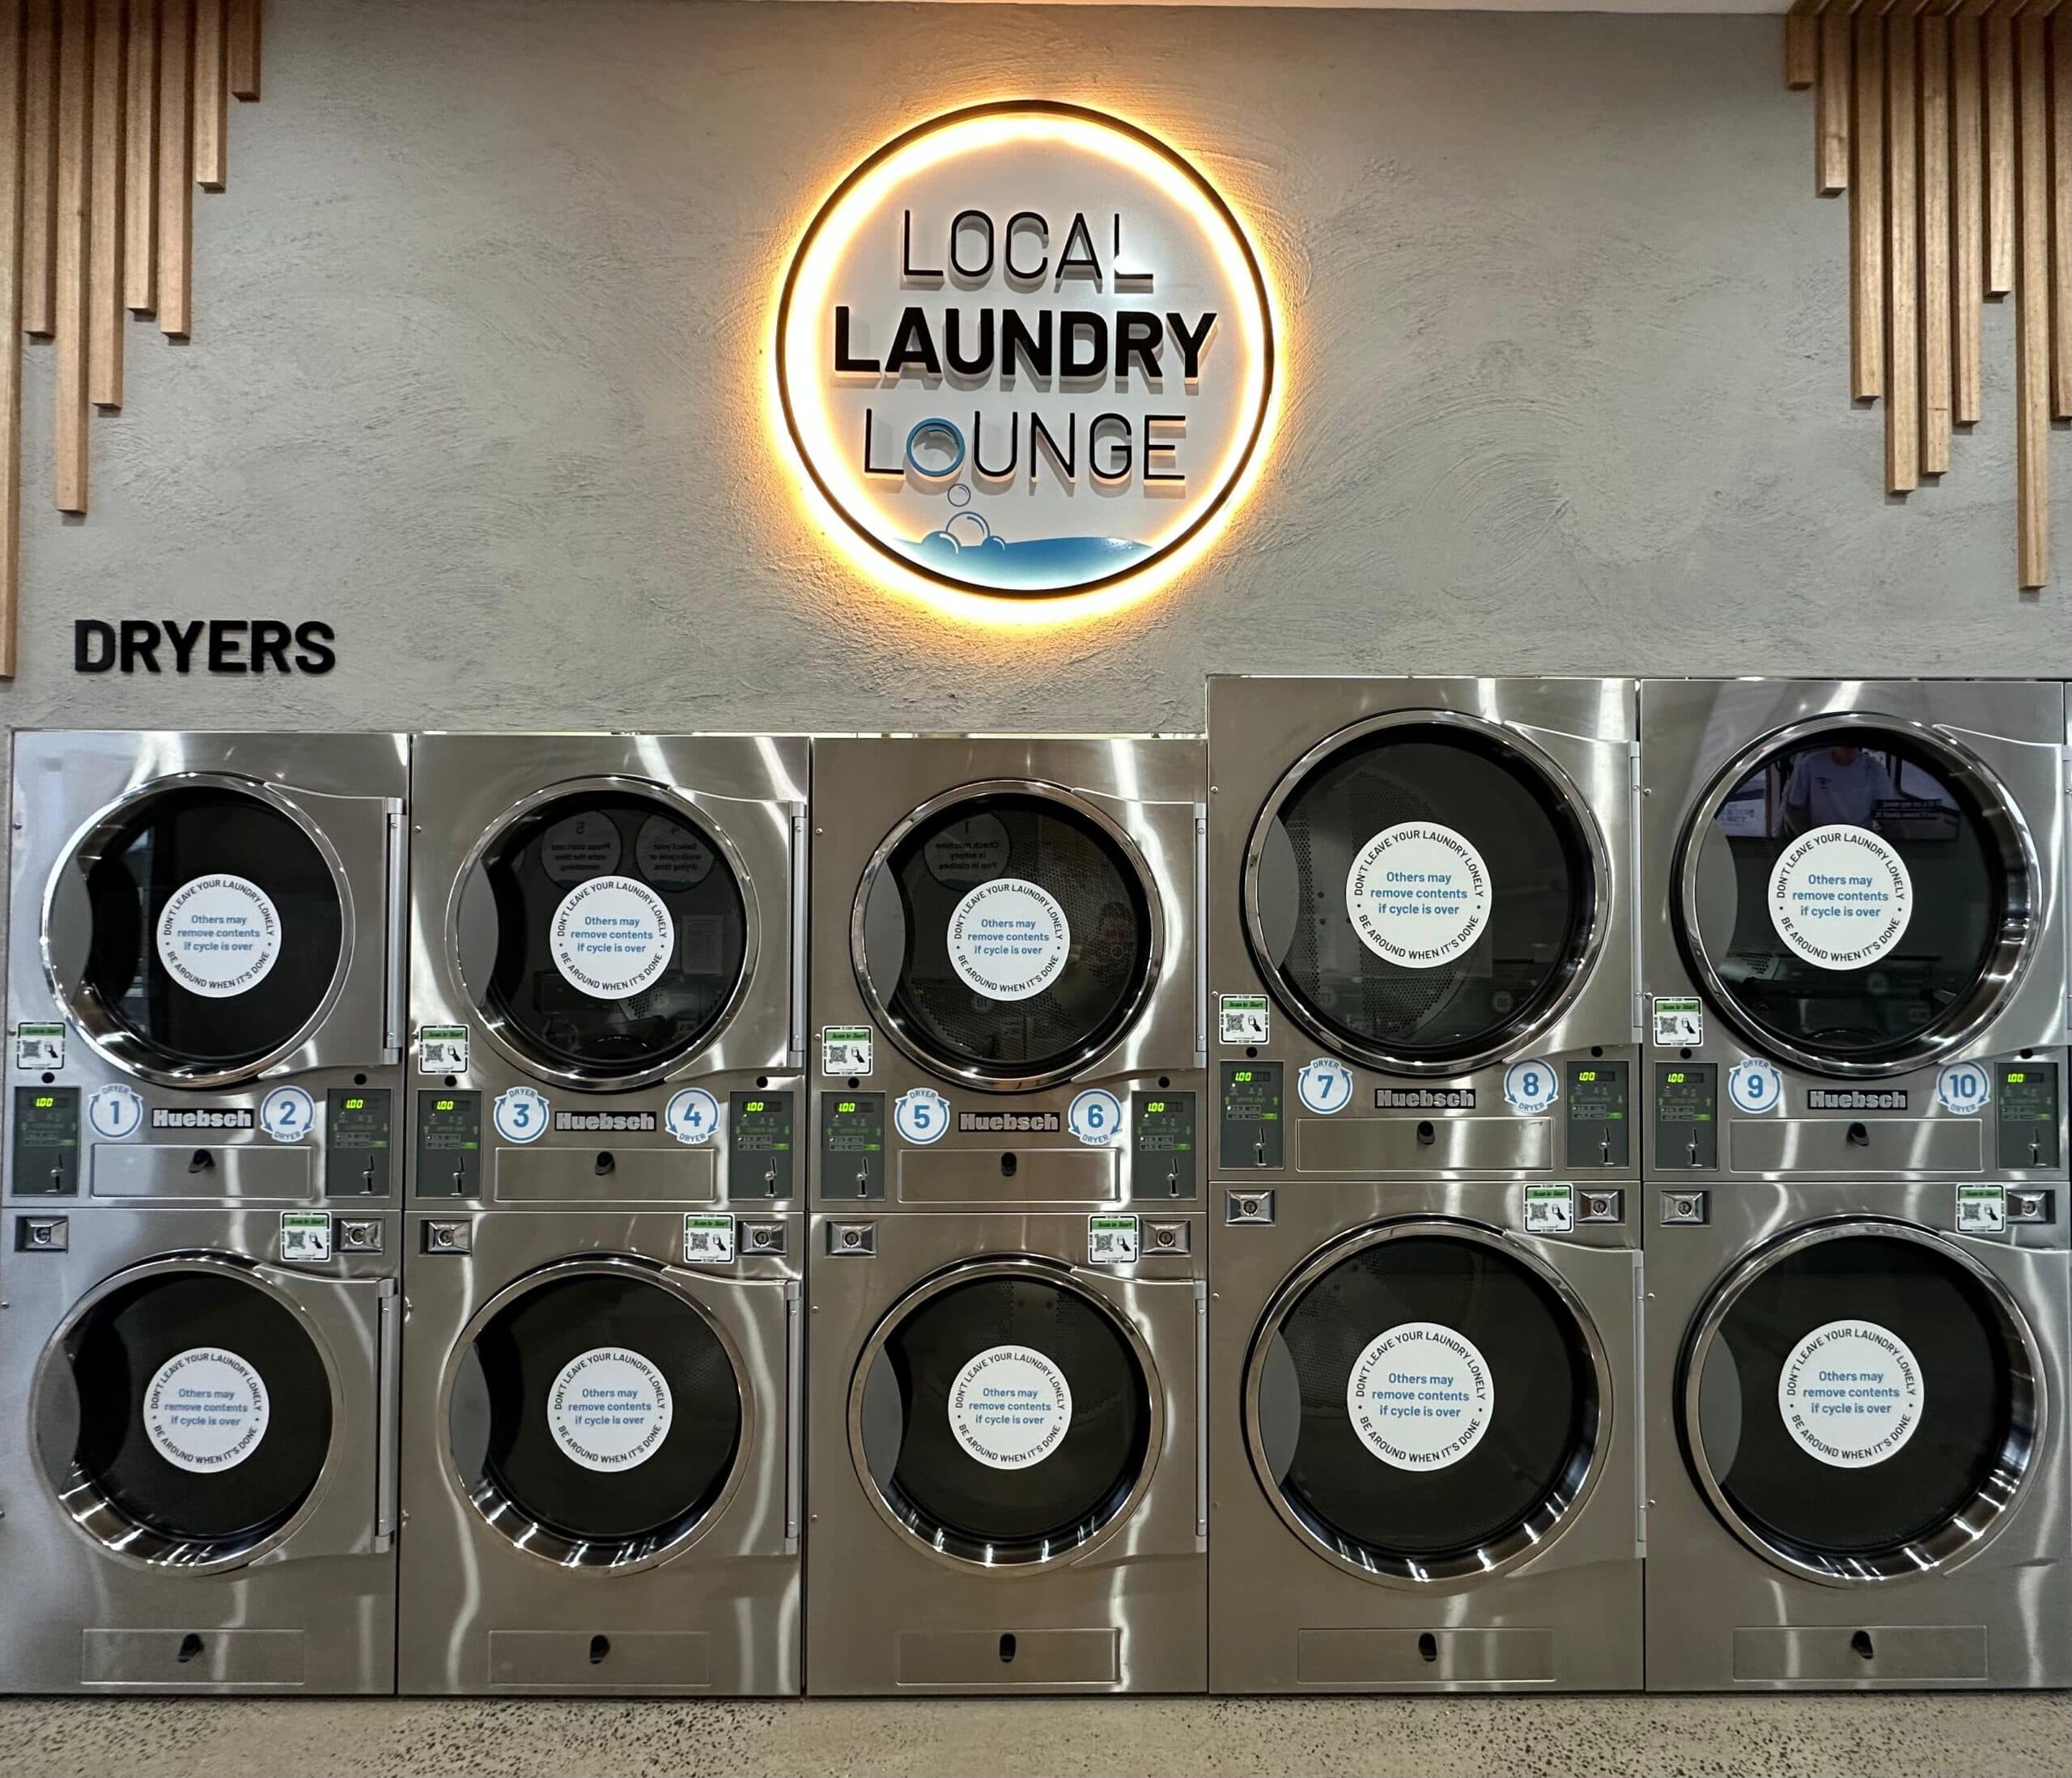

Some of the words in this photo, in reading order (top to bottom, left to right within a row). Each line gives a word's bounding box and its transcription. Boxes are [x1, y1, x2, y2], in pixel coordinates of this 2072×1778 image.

[902, 210, 1153, 282] LOCAL
[834, 305, 1217, 382] LAUNDRY
[864, 408, 1187, 484] LOUNGE
[74, 618, 337, 674] DRYERS
[1776, 867, 1790, 897] DON'T
[1785, 840, 1813, 868] LEAVE
[1813, 833, 1841, 845] YOUR
[1844, 833, 1888, 859] LAUNDRY
[1885, 859, 1904, 899] LONELY
[1386, 871, 1425, 883] Others
[1427, 874, 1452, 885] may
[1808, 874, 1847, 885] Others
[1849, 876, 1873, 888] may
[1370, 889, 1414, 898] remove
[1416, 889, 1468, 899] contents
[1792, 892, 1836, 901] remove
[1837, 891, 1889, 902] contents
[1378, 902, 1387, 914] if
[1389, 903, 1420, 917] cycle
[1421, 903, 1432, 914] is
[1433, 906, 1460, 915] over
[1800, 906, 1809, 916] if
[1811, 906, 1841, 919] cycle
[1843, 906, 1853, 917] is
[1855, 909, 1881, 918] over
[191, 914, 225, 924] Others
[226, 917, 247, 926] may
[584, 916, 618, 926] Others
[619, 919, 640, 928] may
[981, 919, 1014, 928] Others
[1016, 921, 1037, 931] may
[215, 929, 261, 938] contents
[609, 931, 653, 940] contents
[1005, 932, 1050, 942] contents
[1781, 916, 1794, 931] BE
[1790, 931, 1828, 959] AROUND
[1830, 950, 1861, 961] WHEN
[1862, 941, 1880, 956] IT'S
[1879, 918, 1900, 944] DONE
[184, 941, 192, 951] if
[193, 942, 219, 953] cycle
[221, 942, 230, 951] is
[577, 943, 585, 953] if
[586, 944, 613, 954] cycle
[614, 943, 623, 953] is
[974, 945, 982, 954] if
[983, 945, 1009, 957] cycle
[1011, 945, 1020, 955] is
[1021, 947, 1043, 955] over
[1313, 1061, 1340, 1069] DRYER
[1743, 1060, 1768, 1068] DRYER
[102, 1086, 129, 1094] DRYER
[1318, 1076, 1333, 1098] 7
[1523, 1073, 1539, 1097] 8
[1747, 1075, 1763, 1097] 9
[1950, 1075, 1976, 1097] 10
[509, 1089, 536, 1098] DRYER
[909, 1090, 936, 1099] DRYER
[1377, 1090, 1475, 1108] Huebsch
[1810, 1091, 1907, 1109] Huebsch
[110, 1101, 119, 1123] 1
[1518, 1102, 1544, 1110] DRYER
[1950, 1104, 1976, 1112] DRYER
[152, 1110, 252, 1127] Huebsch
[279, 1101, 295, 1125] 2
[513, 1104, 529, 1127] 3
[683, 1103, 702, 1126] 4
[915, 1105, 930, 1128] 5
[1088, 1105, 1103, 1128] 6
[555, 1113, 655, 1131] Huebsch
[960, 1114, 1059, 1131] Huebsch
[274, 1131, 301, 1139] DRYER
[679, 1133, 706, 1142] DRYER
[1082, 1134, 1109, 1143] DRYER
[1355, 1365, 1369, 1397] DON'T
[1365, 1339, 1395, 1366] LEAVE
[1395, 1330, 1423, 1343] YOUR
[1425, 1331, 1471, 1359] LAUNDRY
[1467, 1359, 1485, 1399] LONELY
[1388, 1373, 1428, 1385] Others
[1429, 1376, 1454, 1388] may
[1819, 1371, 1858, 1381] Others
[1859, 1373, 1884, 1384] may
[179, 1389, 212, 1398] Others
[214, 1391, 235, 1401] may
[582, 1388, 615, 1398] Others
[617, 1390, 638, 1399] may
[983, 1387, 1016, 1398] Others
[1017, 1390, 1038, 1400] may
[1372, 1391, 1416, 1400] remove
[1417, 1390, 1470, 1402] contents
[1802, 1389, 1846, 1398] remove
[1848, 1387, 1900, 1398] contents
[203, 1404, 248, 1412] contents
[607, 1402, 652, 1411] contents
[969, 1402, 1006, 1411] remove
[1007, 1402, 1051, 1411] contents
[1379, 1404, 1389, 1415] if
[1391, 1406, 1421, 1419] cycle
[1423, 1406, 1433, 1417] is
[1435, 1408, 1462, 1418] over
[1811, 1402, 1820, 1414] if
[1822, 1402, 1853, 1416] cycle
[1854, 1402, 1865, 1414] is
[1866, 1405, 1892, 1414] over
[171, 1415, 178, 1424] if
[180, 1417, 206, 1427] cycle
[208, 1416, 217, 1425] is
[575, 1415, 583, 1425] if
[584, 1415, 610, 1427] cycle
[612, 1415, 621, 1424] is
[622, 1417, 645, 1425] over
[975, 1415, 983, 1424] if
[984, 1415, 1011, 1426] cycle
[1012, 1415, 1021, 1424] is
[1360, 1415, 1372, 1431] BE
[1367, 1431, 1406, 1459] AROUND
[1409, 1451, 1440, 1462] WHEN
[1441, 1442, 1459, 1458] IT'S
[1458, 1418, 1480, 1445] DONE
